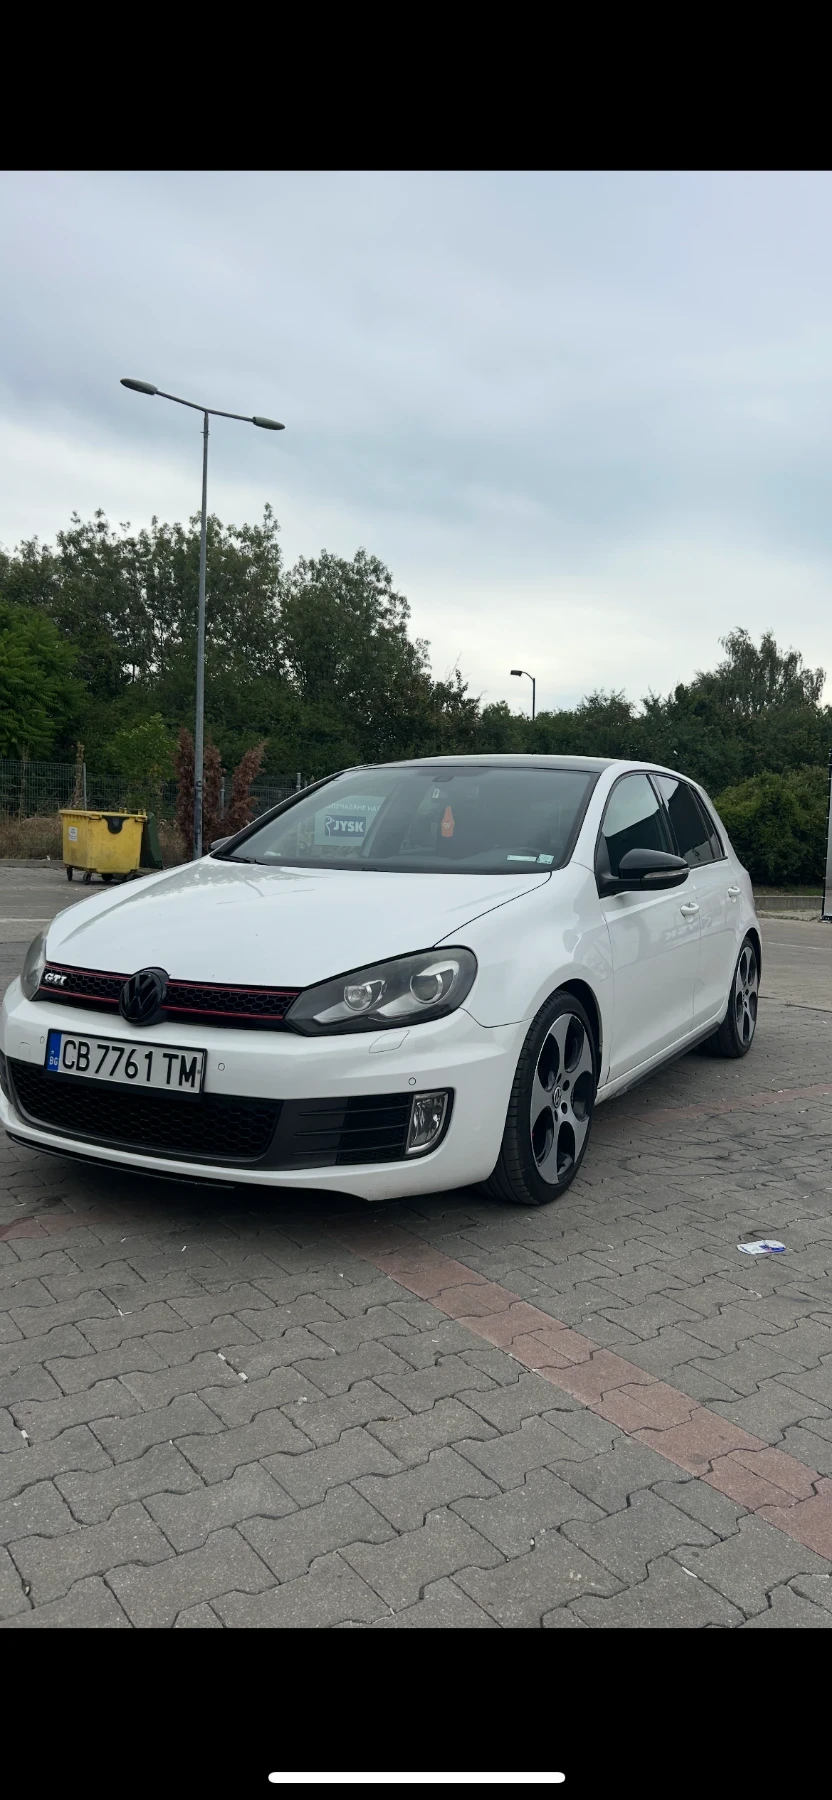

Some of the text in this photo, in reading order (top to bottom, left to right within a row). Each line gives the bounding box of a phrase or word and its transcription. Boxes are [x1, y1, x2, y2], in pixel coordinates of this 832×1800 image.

[333, 820, 364, 832] JYSK
[44, 972, 67, 986] GTI
[49, 1056, 59, 1066] BG
[62, 1040, 198, 1088] CB 7761 TM
